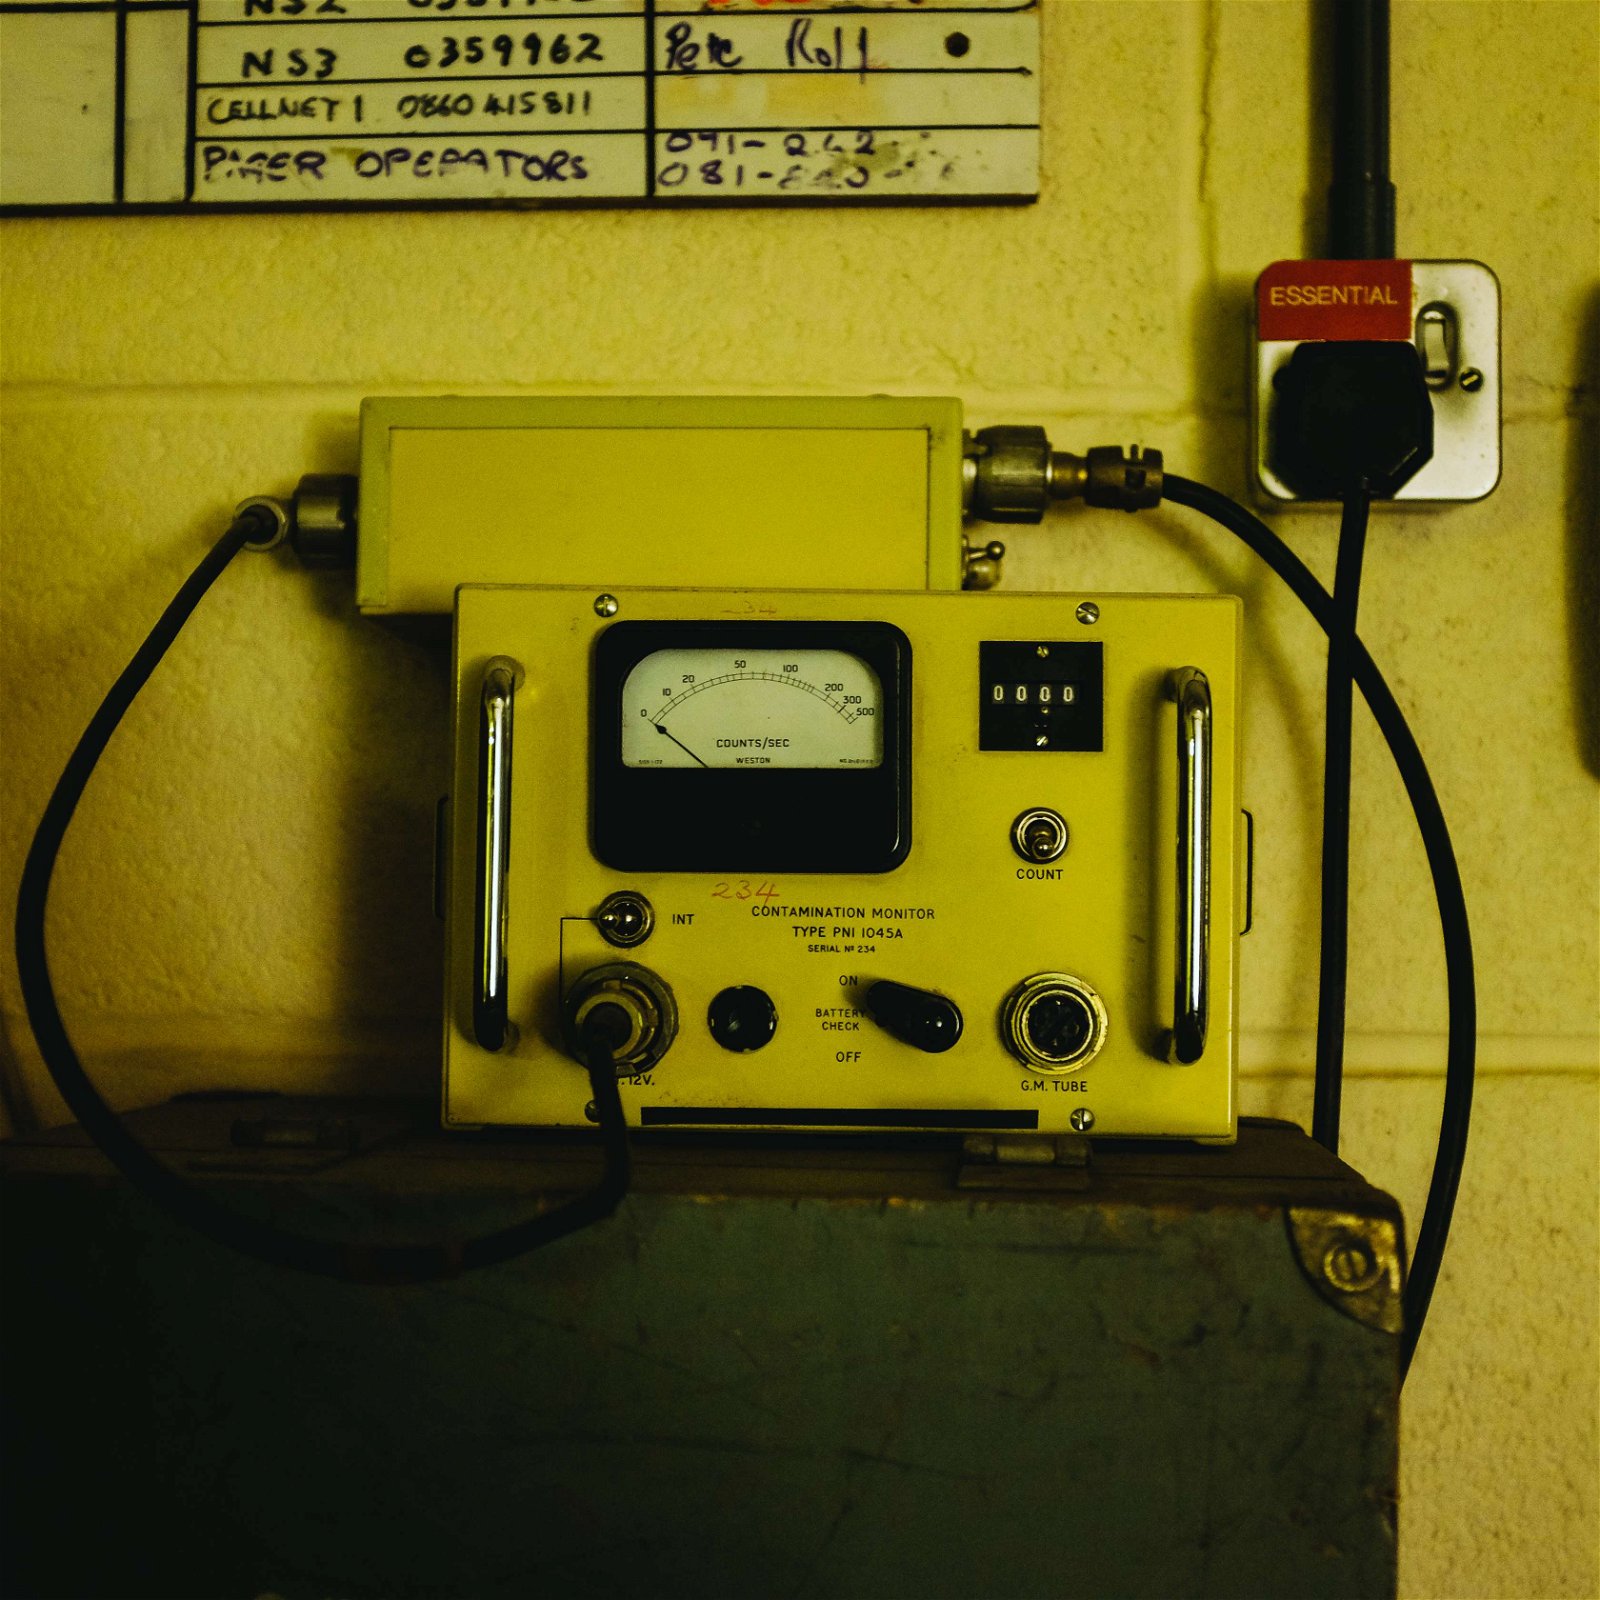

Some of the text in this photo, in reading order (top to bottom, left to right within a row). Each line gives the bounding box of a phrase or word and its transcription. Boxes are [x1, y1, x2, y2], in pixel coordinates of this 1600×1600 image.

[404, 32, 603, 68] 0359962
[207, 96, 340, 124] CELLNET
[1270, 285, 1398, 306] ESSENTIAL
[734, 660, 746, 669] 50
[783, 664, 799, 673] 100
[682, 674, 695, 683] 20
[662, 688, 671, 696] 10
[824, 683, 844, 692] 200
[843, 695, 861, 704] 300
[640, 708, 647, 717] 0
[856, 707, 875, 716] 500
[716, 737, 790, 750] COUNTS/SEC
[1016, 868, 1064, 880] COUNT
[711, 880, 780, 905] 234
[751, 905, 935, 919] CONTAMINATION MONITOR
[672, 914, 695, 925] INT
[792, 926, 903, 938] TYPE PNI 1045A
[807, 944, 840, 953] SERIAL
[857, 945, 876, 953] 234
[839, 975, 858, 986] ON
[815, 1008, 865, 1018] BATTERY
[821, 1021, 860, 1031] CHECK
[836, 1051, 861, 1063] OFF
[1021, 1080, 1088, 1092] G.M. TUBE
